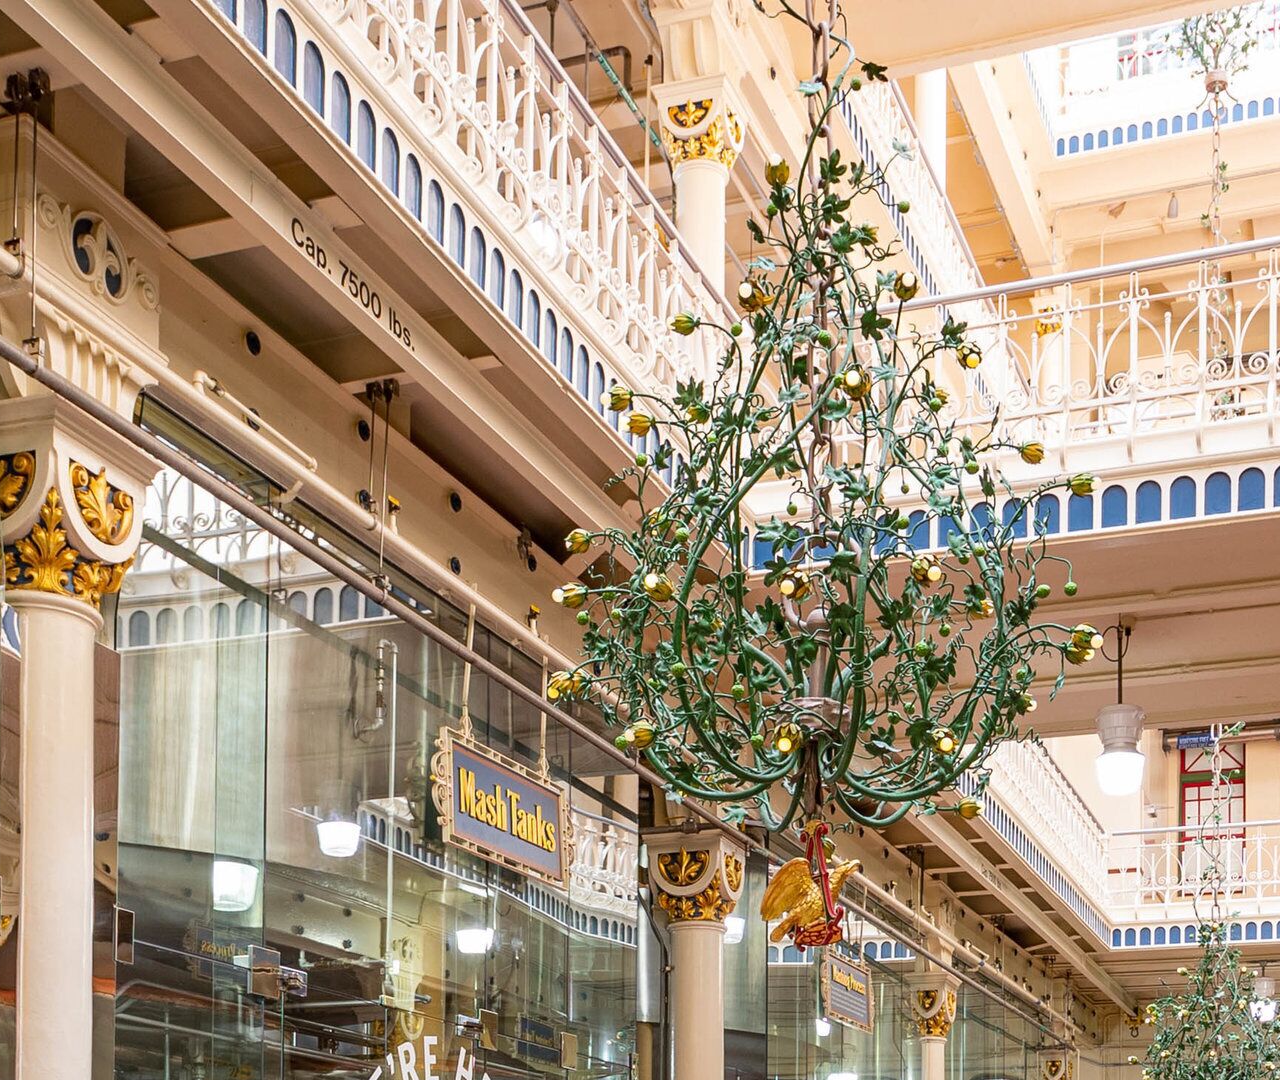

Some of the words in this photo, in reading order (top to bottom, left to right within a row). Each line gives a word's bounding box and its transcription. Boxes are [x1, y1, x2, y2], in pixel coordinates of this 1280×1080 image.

[291, 217, 332, 275] Cap.
[339, 259, 382, 319] 7500
[388, 306, 415, 352] lbs.
[458, 766, 507, 832] Mash
[507, 788, 556, 852] Tanks
